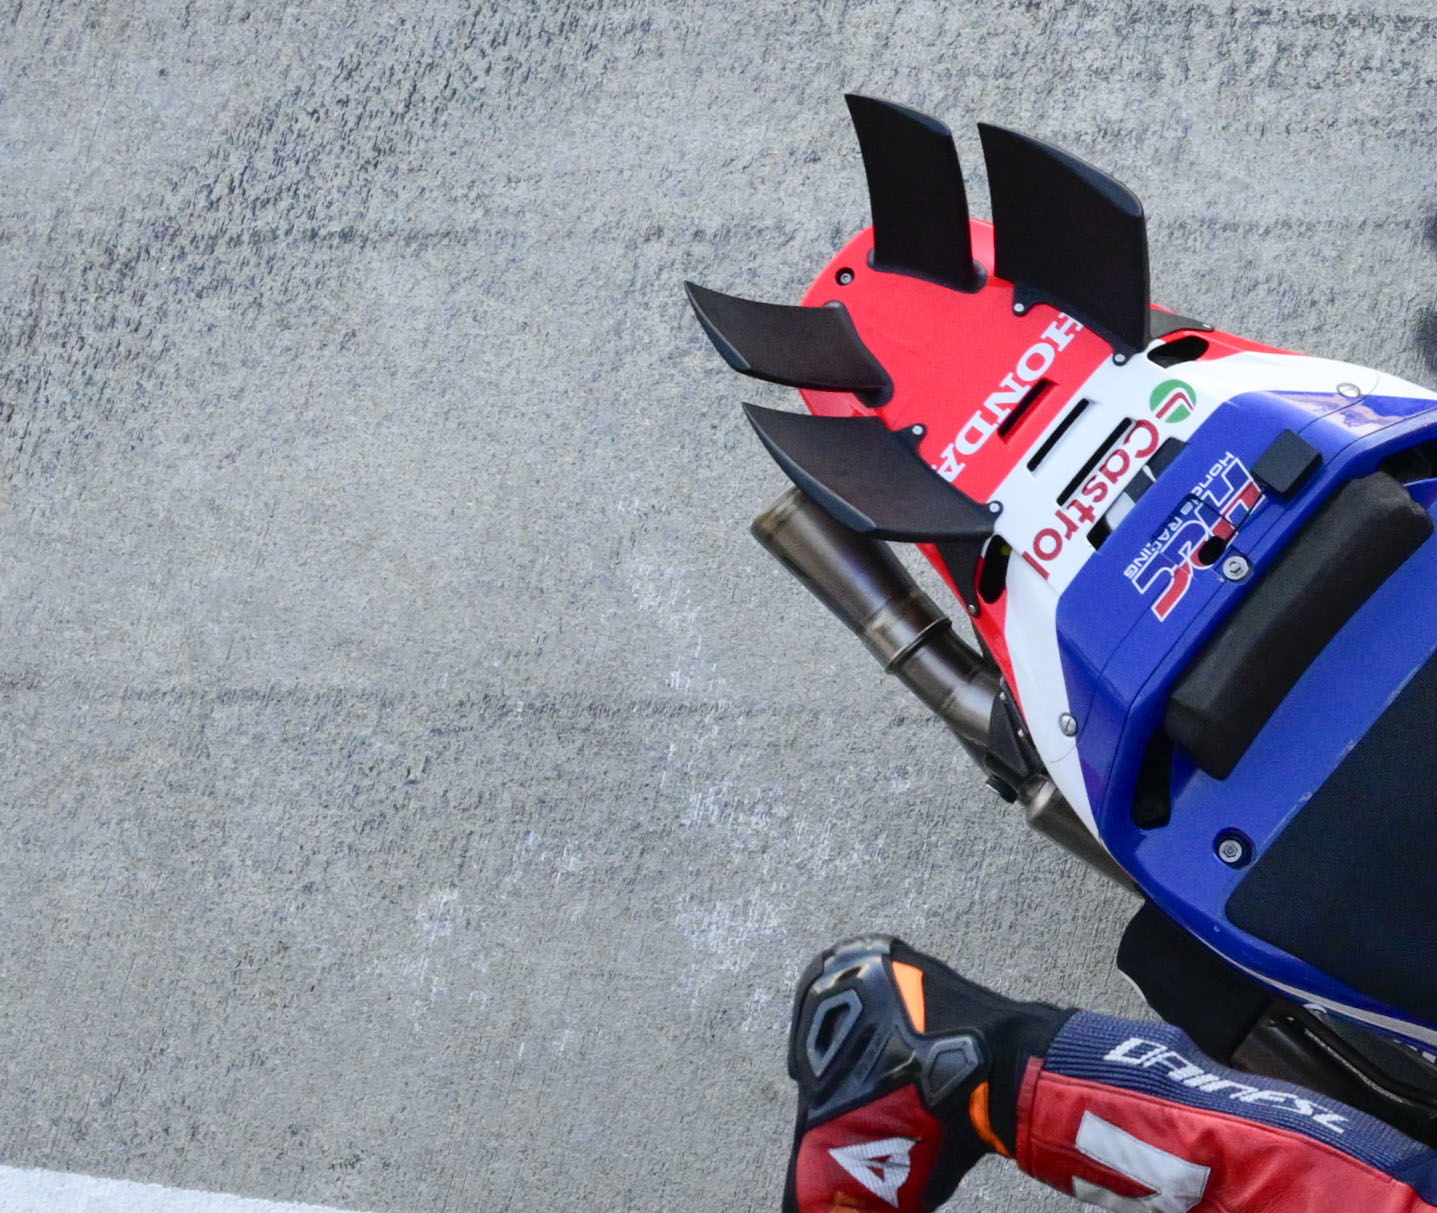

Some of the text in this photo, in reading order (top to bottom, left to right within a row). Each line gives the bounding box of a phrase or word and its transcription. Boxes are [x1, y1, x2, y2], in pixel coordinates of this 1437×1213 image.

[933, 312, 1083, 483] HONDA
[1023, 419, 1159, 580] Castrol
[1132, 456, 1264, 622] HRC
[1104, 1037, 1349, 1134] DAINESE
